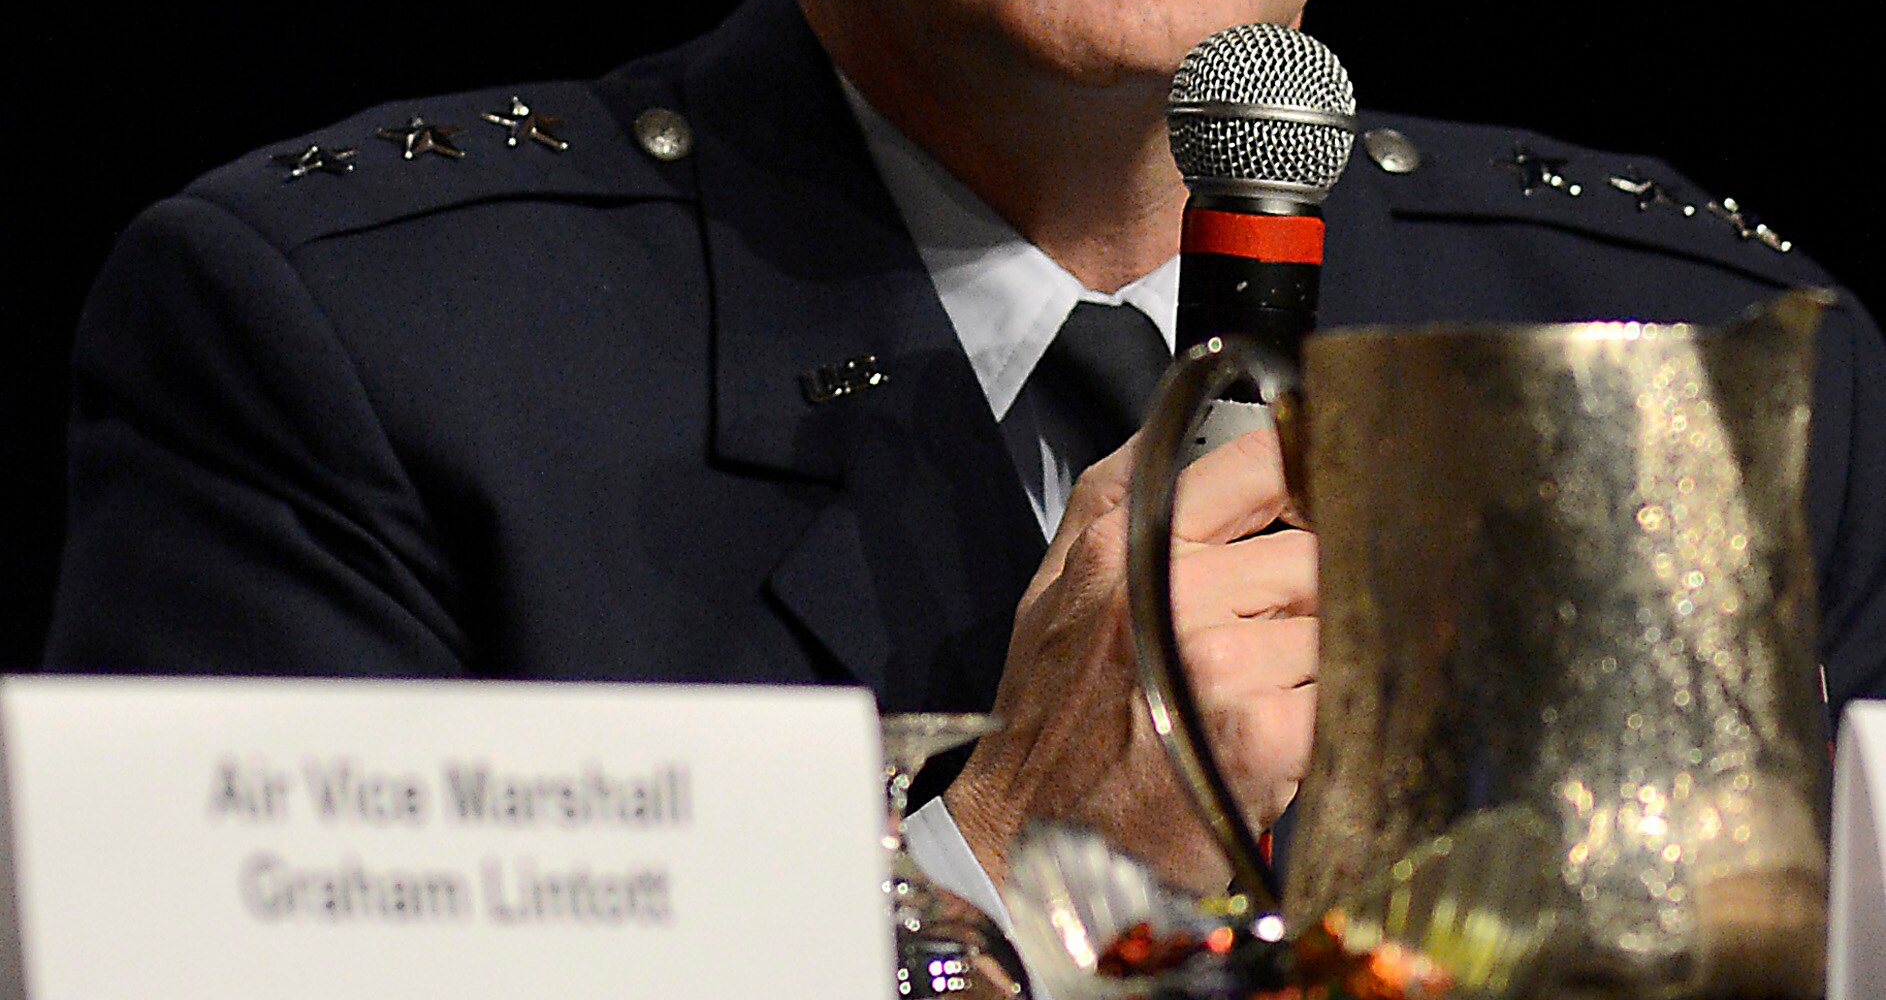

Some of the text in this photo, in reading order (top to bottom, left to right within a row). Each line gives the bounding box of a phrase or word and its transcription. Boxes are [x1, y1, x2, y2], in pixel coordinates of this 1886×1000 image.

[209, 756, 694, 830] Air Vice Marshall
[240, 852, 674, 926] Graham Lintott
